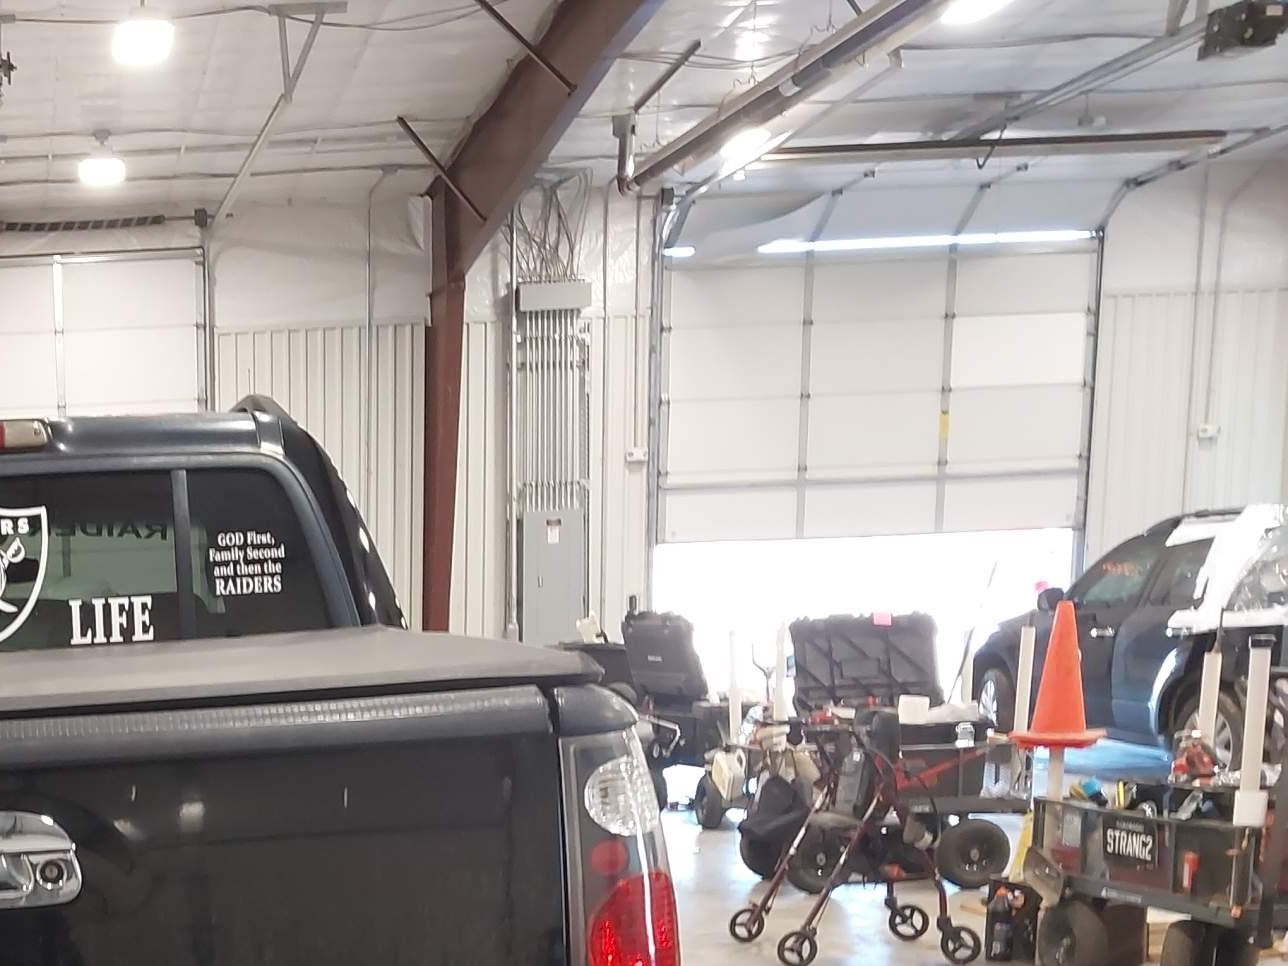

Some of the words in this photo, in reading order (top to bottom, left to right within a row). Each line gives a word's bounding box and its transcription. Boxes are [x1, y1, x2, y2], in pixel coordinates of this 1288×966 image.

[217, 532, 244, 547] GOD
[246, 530, 275, 545] First,
[209, 546, 244, 562] Family
[246, 543, 285, 560] Second
[214, 562, 234, 577] and
[236, 561, 262, 576] then
[263, 560, 282, 574] the
[215, 574, 282, 596] RAIDERS
[69, 596, 155, 645] LIFE
